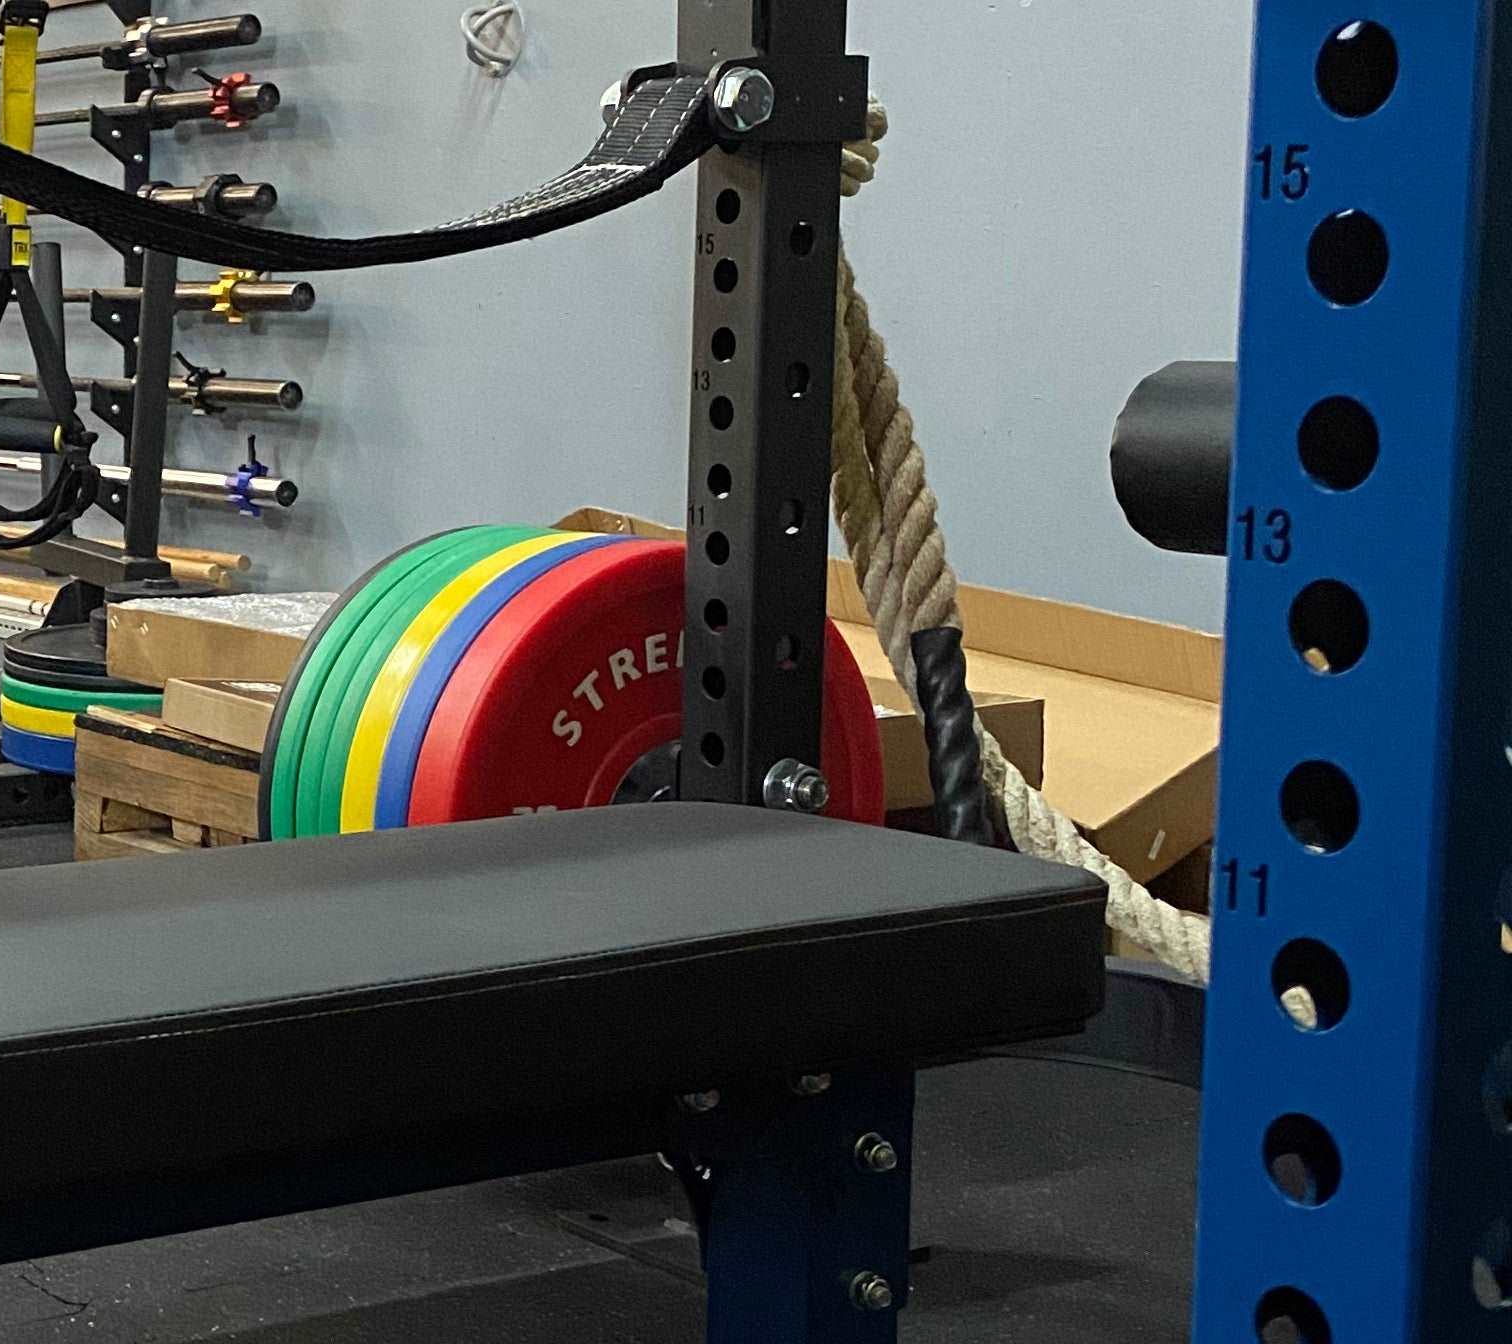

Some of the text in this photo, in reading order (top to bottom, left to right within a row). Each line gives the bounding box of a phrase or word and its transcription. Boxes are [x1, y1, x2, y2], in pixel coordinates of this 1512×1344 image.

[1253, 143, 1311, 201] 15
[696, 233, 715, 256] 15
[693, 370, 711, 392] 13
[690, 505, 705, 528] 11
[1236, 507, 1292, 564] 13
[1221, 857, 1270, 918] 11
